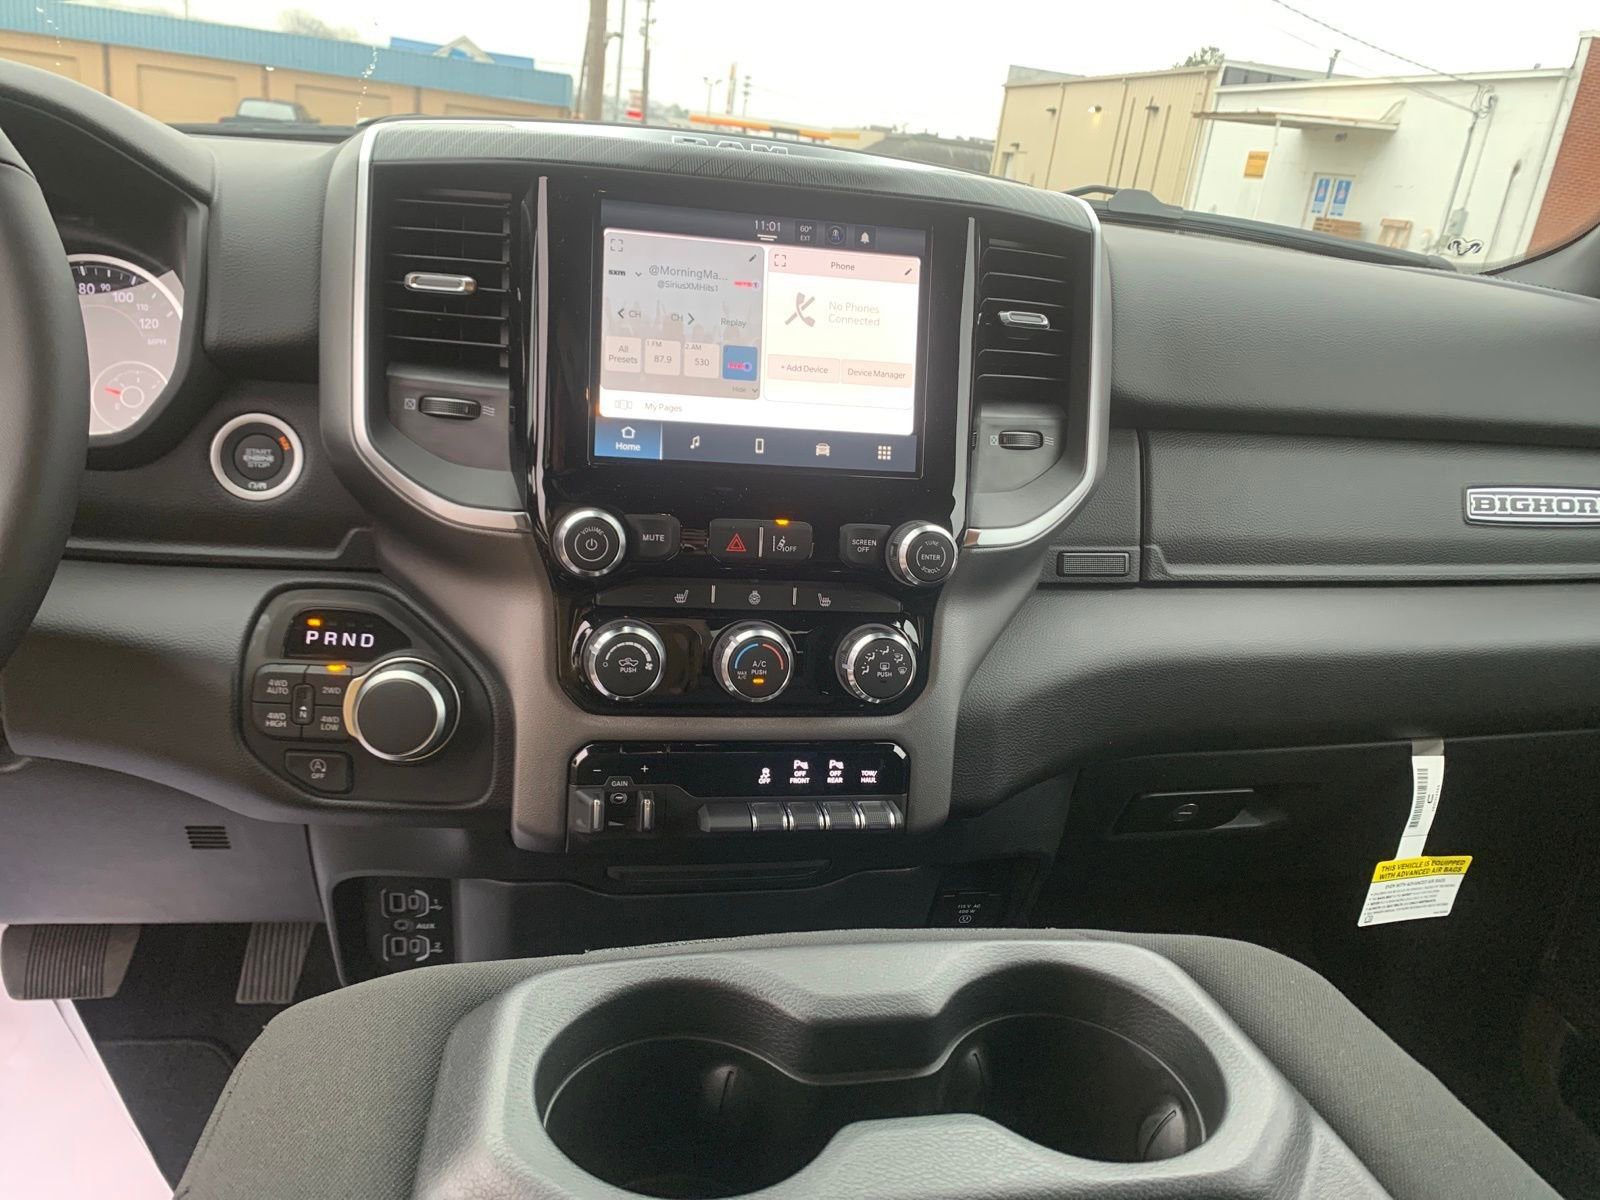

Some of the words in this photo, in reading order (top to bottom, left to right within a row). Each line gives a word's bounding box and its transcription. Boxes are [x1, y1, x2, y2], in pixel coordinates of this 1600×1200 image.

[754, 219, 781, 232] 11:01
[831, 261, 855, 271] Phone
[78, 282, 96, 296] 80
[100, 283, 111, 292] 90
[113, 291, 134, 304] 100
[136, 303, 149, 312] 110
[828, 300, 843, 312] No
[845, 300, 880, 315] Phones
[628, 309, 641, 319] CH
[671, 313, 683, 322] CH
[139, 317, 159, 330] 120
[720, 316, 747, 329] Replay
[828, 313, 880, 327] Connected
[147, 338, 166, 346] MPH
[691, 343, 702, 351] AM
[618, 345, 629, 354] All
[608, 354, 638, 365] Presets
[653, 354, 673, 365] 87.9
[695, 357, 710, 367] 530
[786, 364, 802, 373] Add
[804, 365, 829, 375] Device
[847, 367, 872, 377] Device
[873, 369, 906, 381] Manager
[644, 402, 657, 413] My
[658, 403, 683, 414] Pages
[615, 441, 641, 452] Home
[1470, 494, 1600, 516] BIGHOR
[642, 533, 665, 542] MUTE
[852, 538, 877, 547] SCREEN
[921, 553, 941, 561] ENTER
[921, 566, 941, 574] SCROLL
[752, 660, 767, 668] A/C
[268, 679, 288, 688] 4WD
[266, 687, 289, 695] AUTO
[322, 686, 341, 695] 2WD
[267, 712, 286, 720] 4WD
[320, 715, 340, 724] 4WD
[265, 719, 286, 728] HIGH
[320, 723, 339, 731] LOW
[1381, 865, 1396, 873] THIS
[1397, 861, 1424, 871] VEHICLE
[1431, 859, 1466, 868] EQUIPPED
[1379, 872, 1395, 880] WITH
[1396, 868, 1431, 878] ADVANCED
